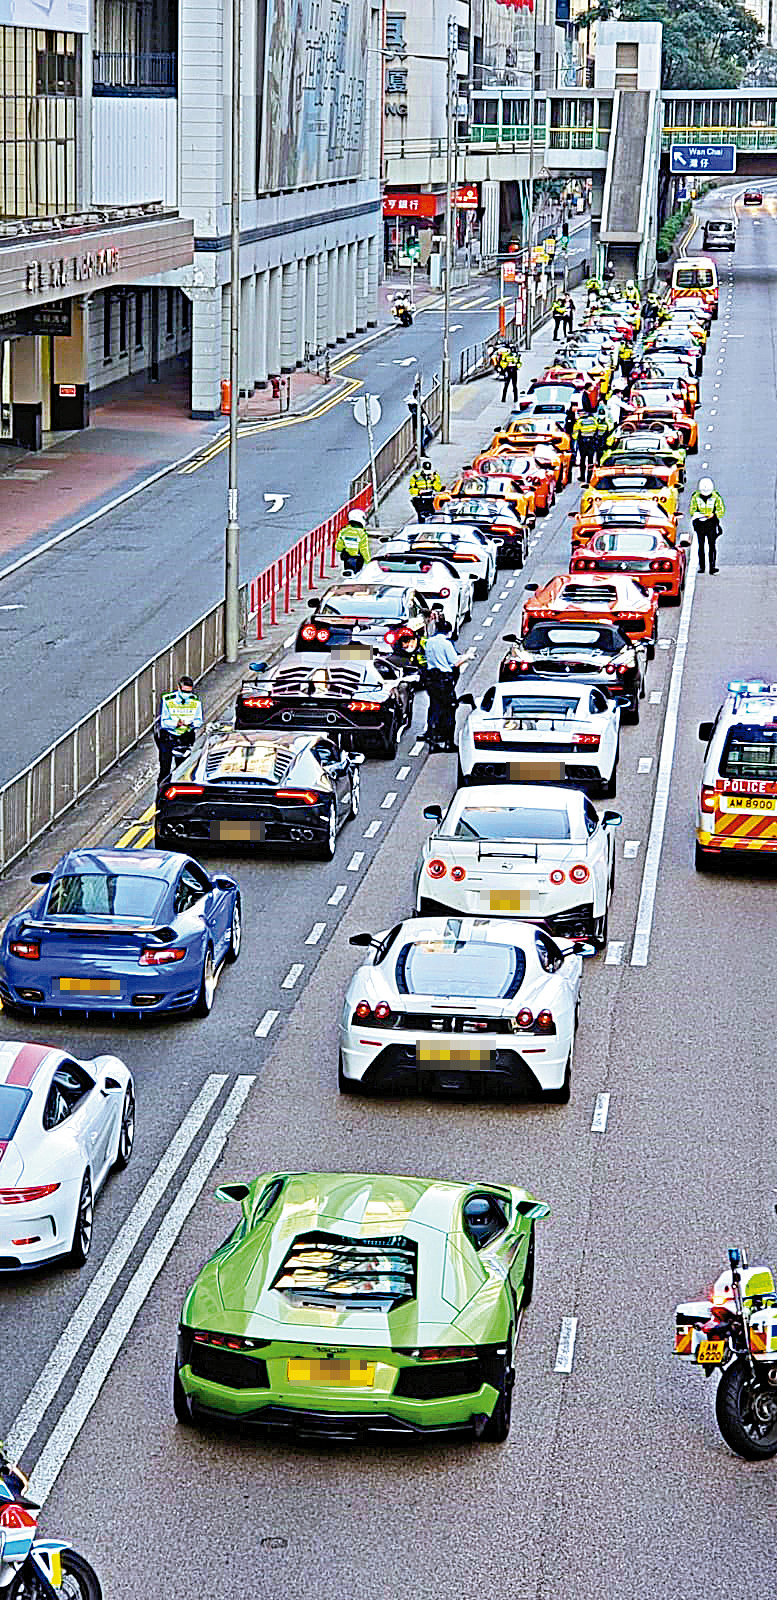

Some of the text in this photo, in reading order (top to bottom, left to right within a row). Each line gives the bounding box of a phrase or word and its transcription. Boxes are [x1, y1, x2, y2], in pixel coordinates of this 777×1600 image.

[724, 780, 766, 792] POLICE
[730, 799, 773, 809] AM 8900
[706, 1343, 718, 1351] AM
[700, 1352, 721, 1360] 6220
